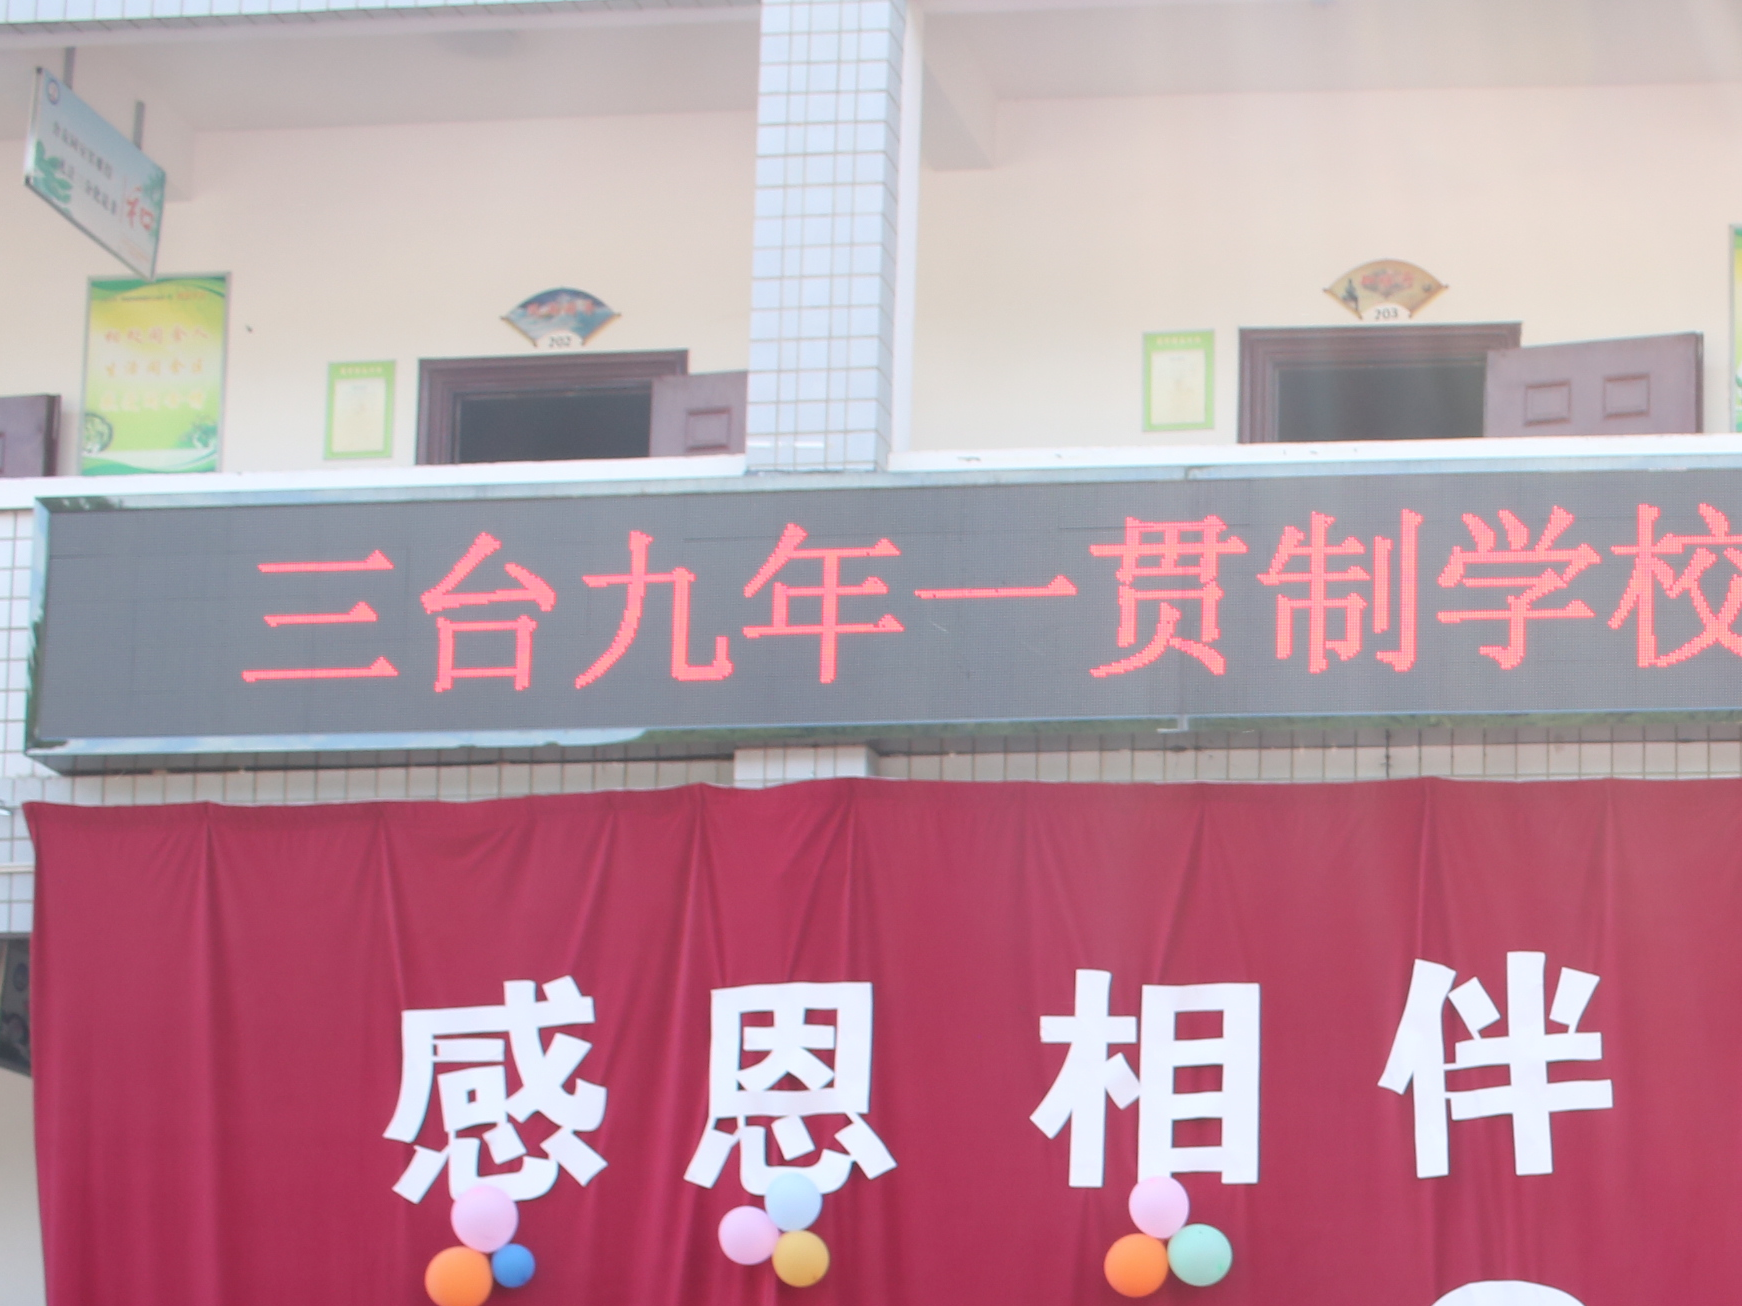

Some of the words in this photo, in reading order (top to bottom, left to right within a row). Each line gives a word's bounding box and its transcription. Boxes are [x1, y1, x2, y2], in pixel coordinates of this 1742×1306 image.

[1374, 307, 1399, 321] 203
[548, 334, 573, 348] 202
[384, 952, 1613, 1203] 感恩相伴
